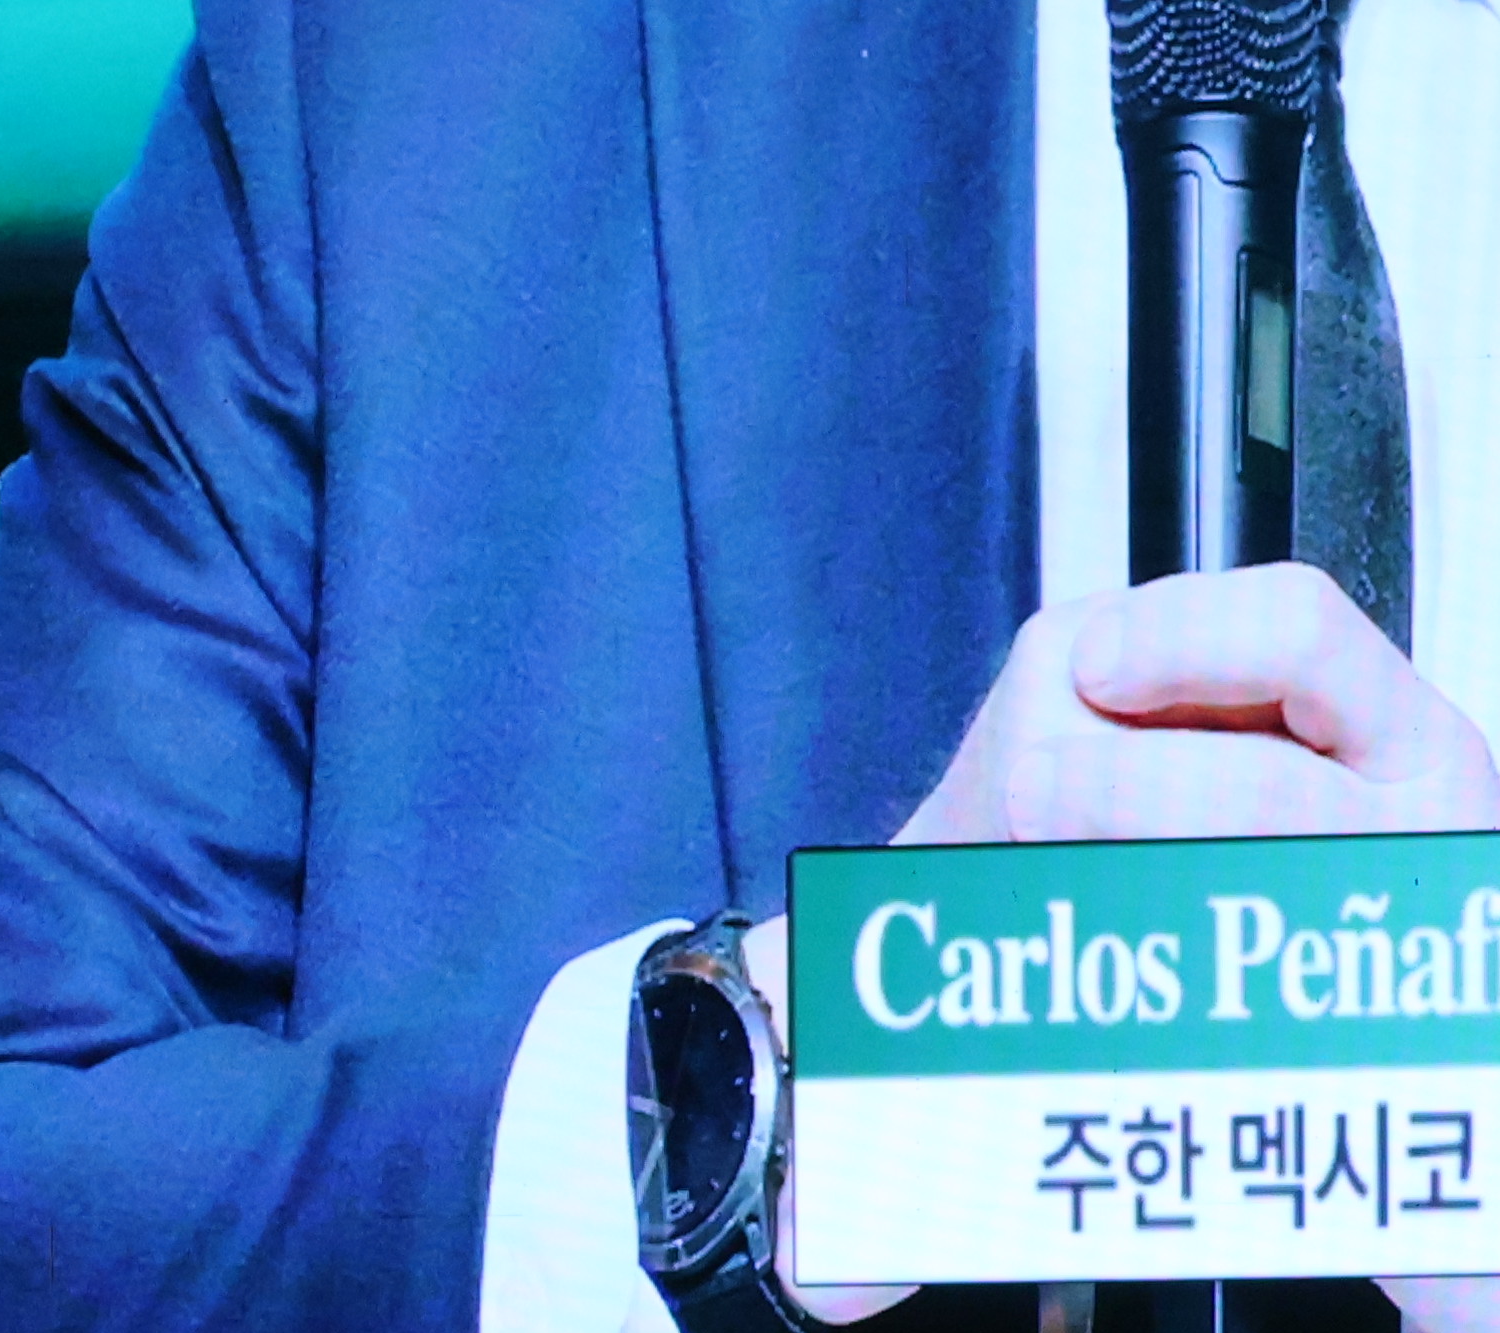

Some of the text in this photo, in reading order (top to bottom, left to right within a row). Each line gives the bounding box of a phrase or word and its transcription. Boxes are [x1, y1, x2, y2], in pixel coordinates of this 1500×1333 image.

[853, 899, 1184, 1031] Carlos
[1036, 1107, 1204, 1232] 주한
[1230, 1103, 1480, 1230] 멕시코
